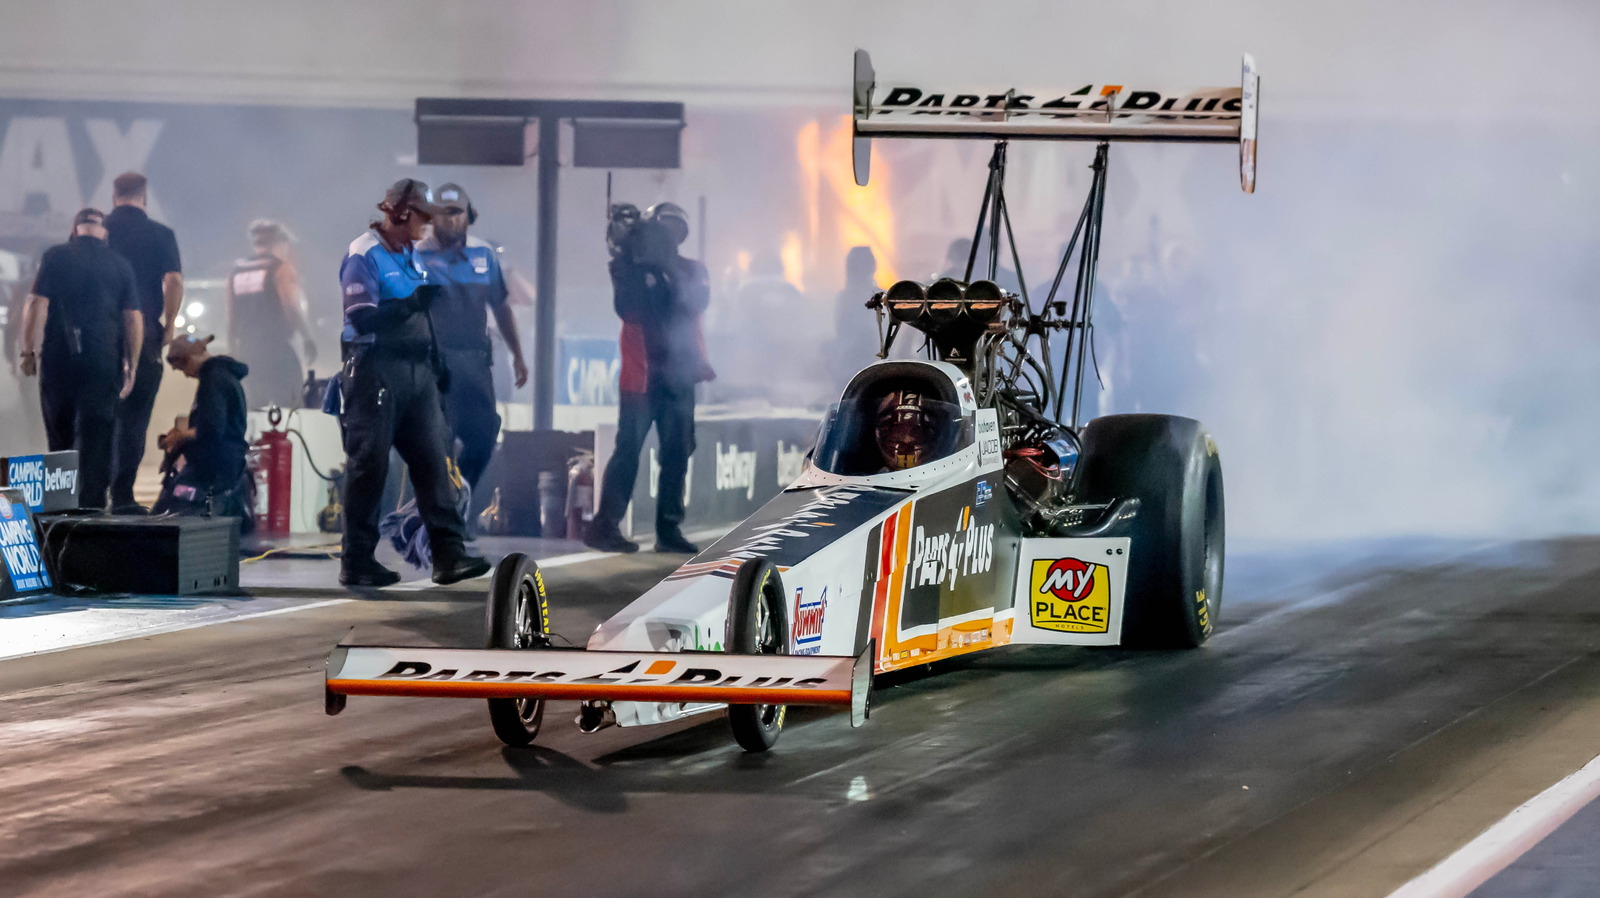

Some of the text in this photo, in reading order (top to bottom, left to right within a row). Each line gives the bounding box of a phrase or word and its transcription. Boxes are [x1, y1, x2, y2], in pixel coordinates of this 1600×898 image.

[9, 460, 43, 484] CAMPING
[44, 467, 78, 495] betway
[2, 543, 43, 576] WORLD
[963, 515, 995, 577] PLUS
[1036, 601, 1104, 623] PLACE
[1055, 623, 1084, 631] HOTELS
[375, 661, 567, 683] PARTS
[667, 668, 828, 689] PLUS
